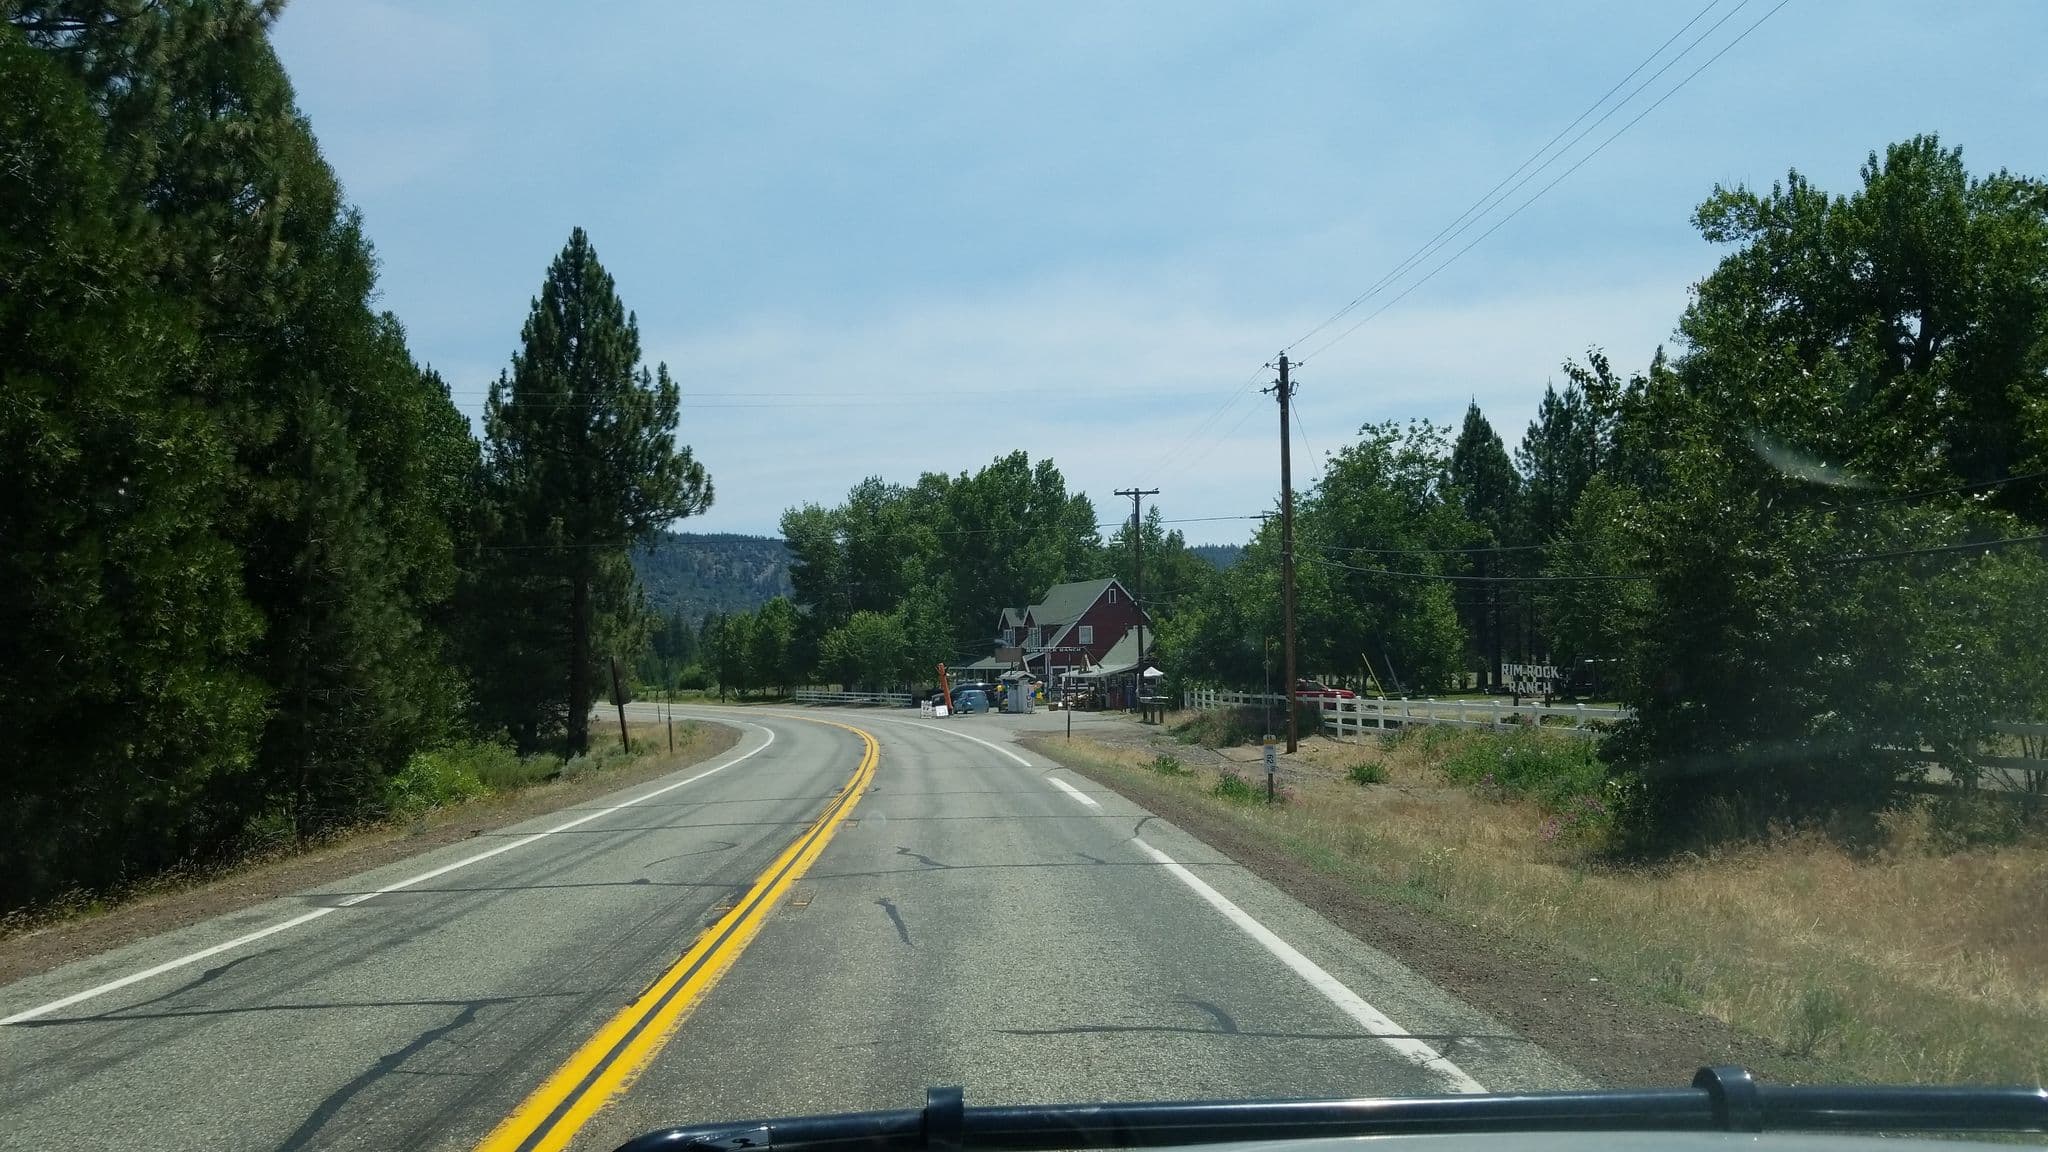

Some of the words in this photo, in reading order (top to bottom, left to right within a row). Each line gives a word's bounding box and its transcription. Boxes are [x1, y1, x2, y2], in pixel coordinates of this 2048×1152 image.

[1501, 663, 1523, 677] RIM
[1527, 665, 1560, 679] ROCK
[1509, 681, 1552, 694] RANCH
